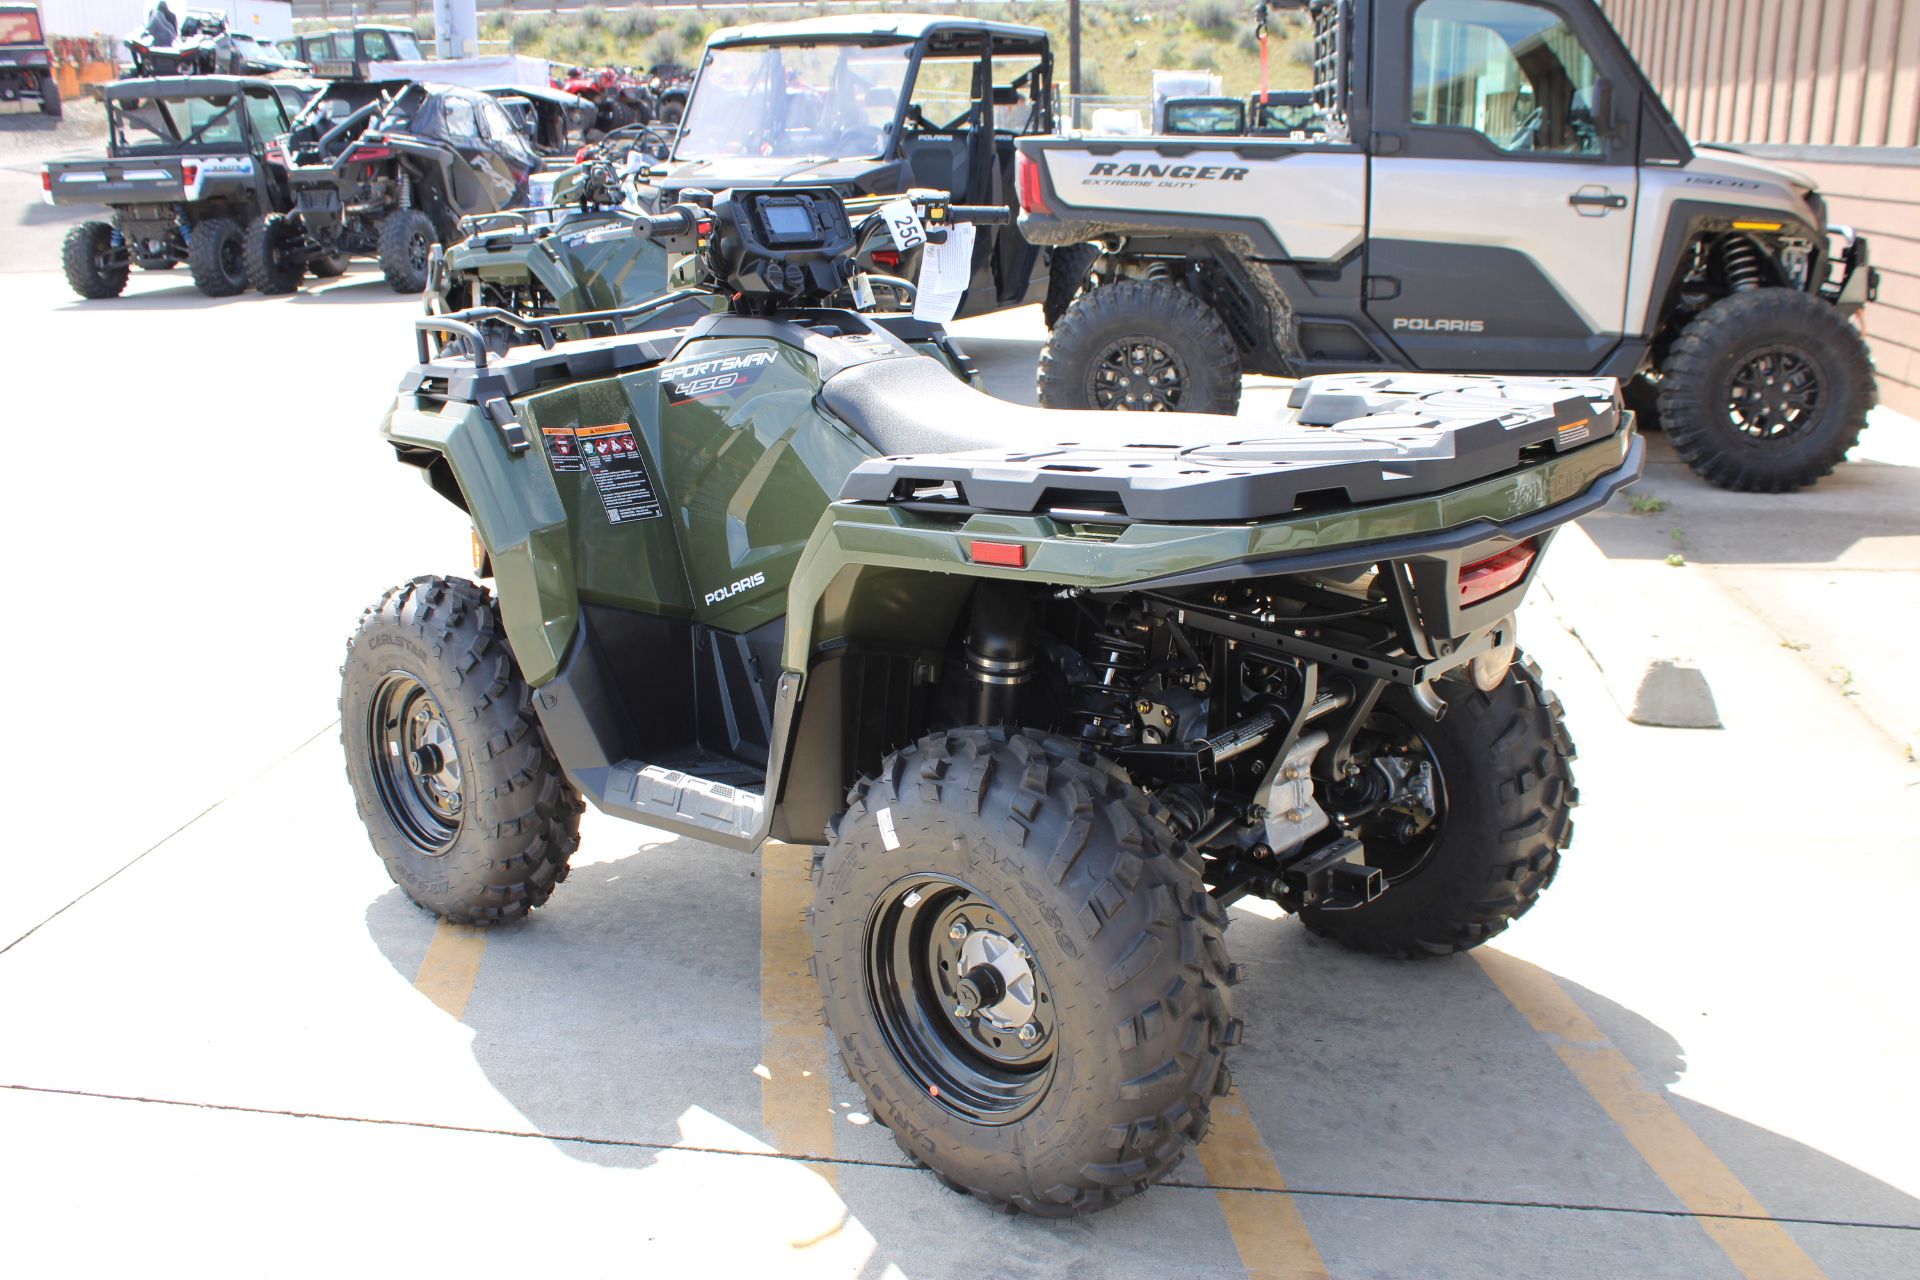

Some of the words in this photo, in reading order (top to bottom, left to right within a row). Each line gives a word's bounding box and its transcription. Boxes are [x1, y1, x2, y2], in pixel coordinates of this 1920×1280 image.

[1089, 162, 1250, 181] RANGER
[1082, 179, 1153, 188] EXTREME
[1158, 181, 1198, 189] DUTY
[894, 216, 922, 248] 250
[1392, 318, 1485, 333] POLARIS
[659, 351, 778, 383] SPORTSMAN
[675, 372, 738, 396] 450
[704, 571, 765, 606] POLARIS
